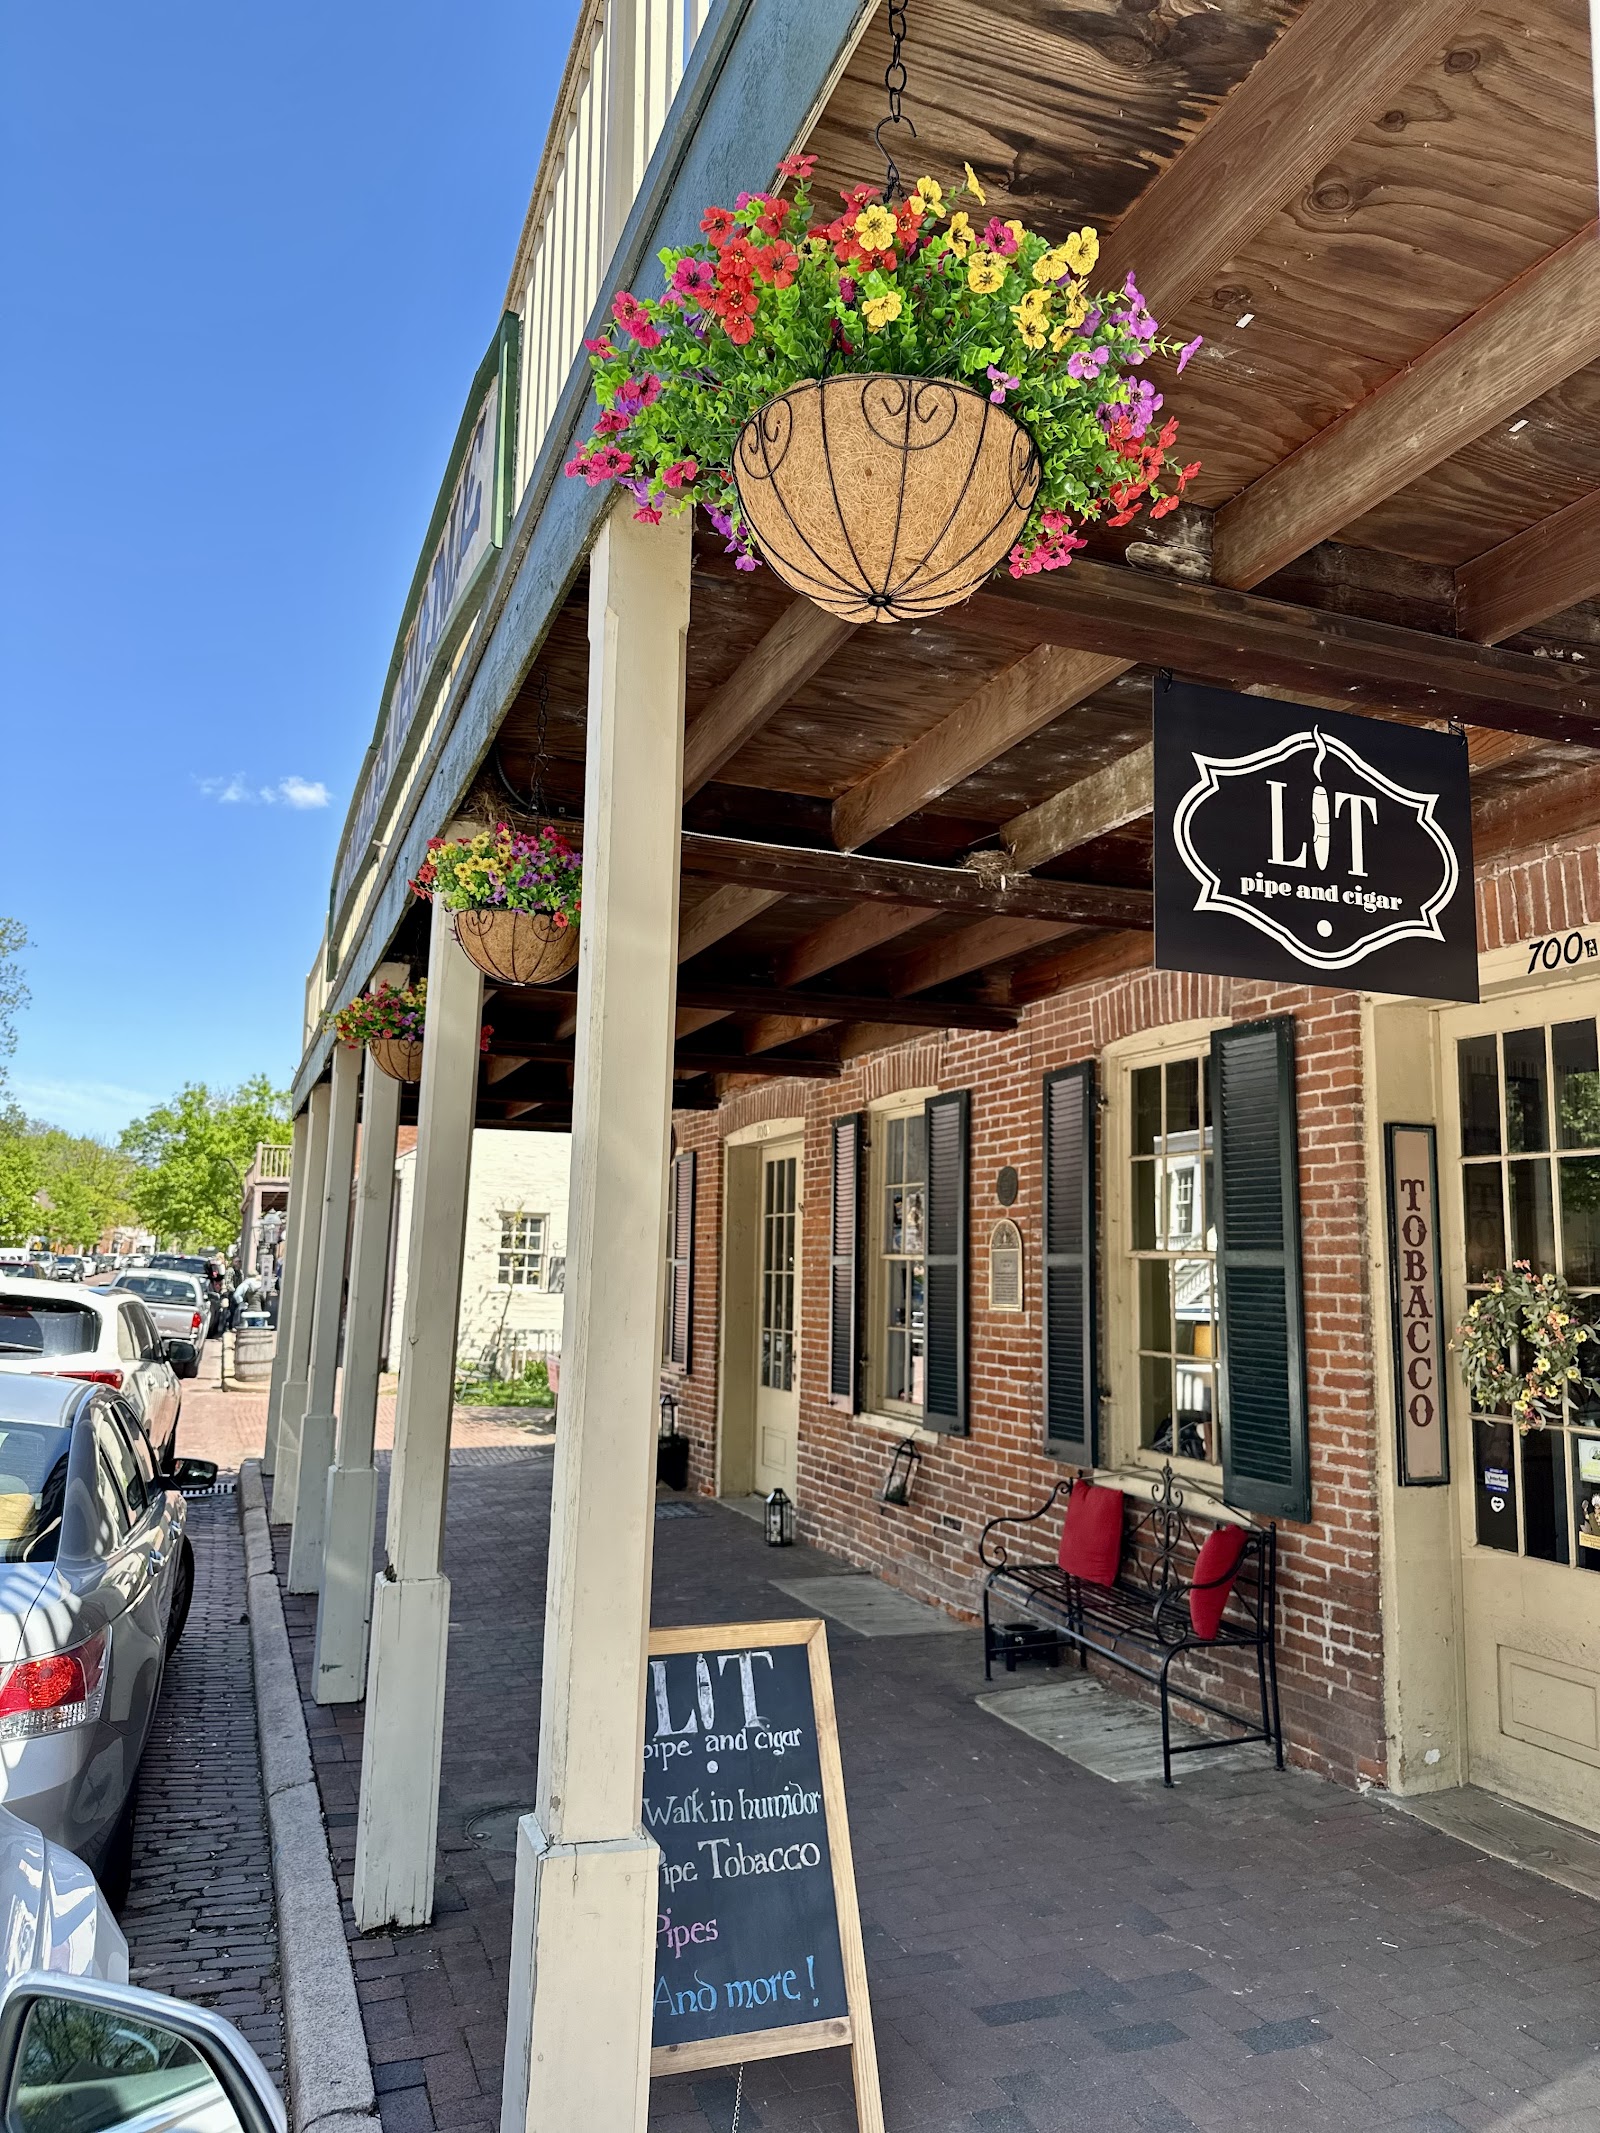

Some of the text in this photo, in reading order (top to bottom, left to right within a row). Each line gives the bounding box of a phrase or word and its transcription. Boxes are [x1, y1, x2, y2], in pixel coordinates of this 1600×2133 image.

[1266, 780, 1378, 877] LIT
[1240, 871, 1403, 913] pipe and cigar
[1400, 1178, 1434, 1427] TOBACCO
[650, 1650, 774, 1737] LIT
[705, 1728, 748, 1752] and
[754, 1724, 803, 1756] cigar
[642, 1780, 822, 1826] Walk in humidor
[659, 1837, 821, 1893] ipe Tobacco
[653, 1969, 718, 2018] And
